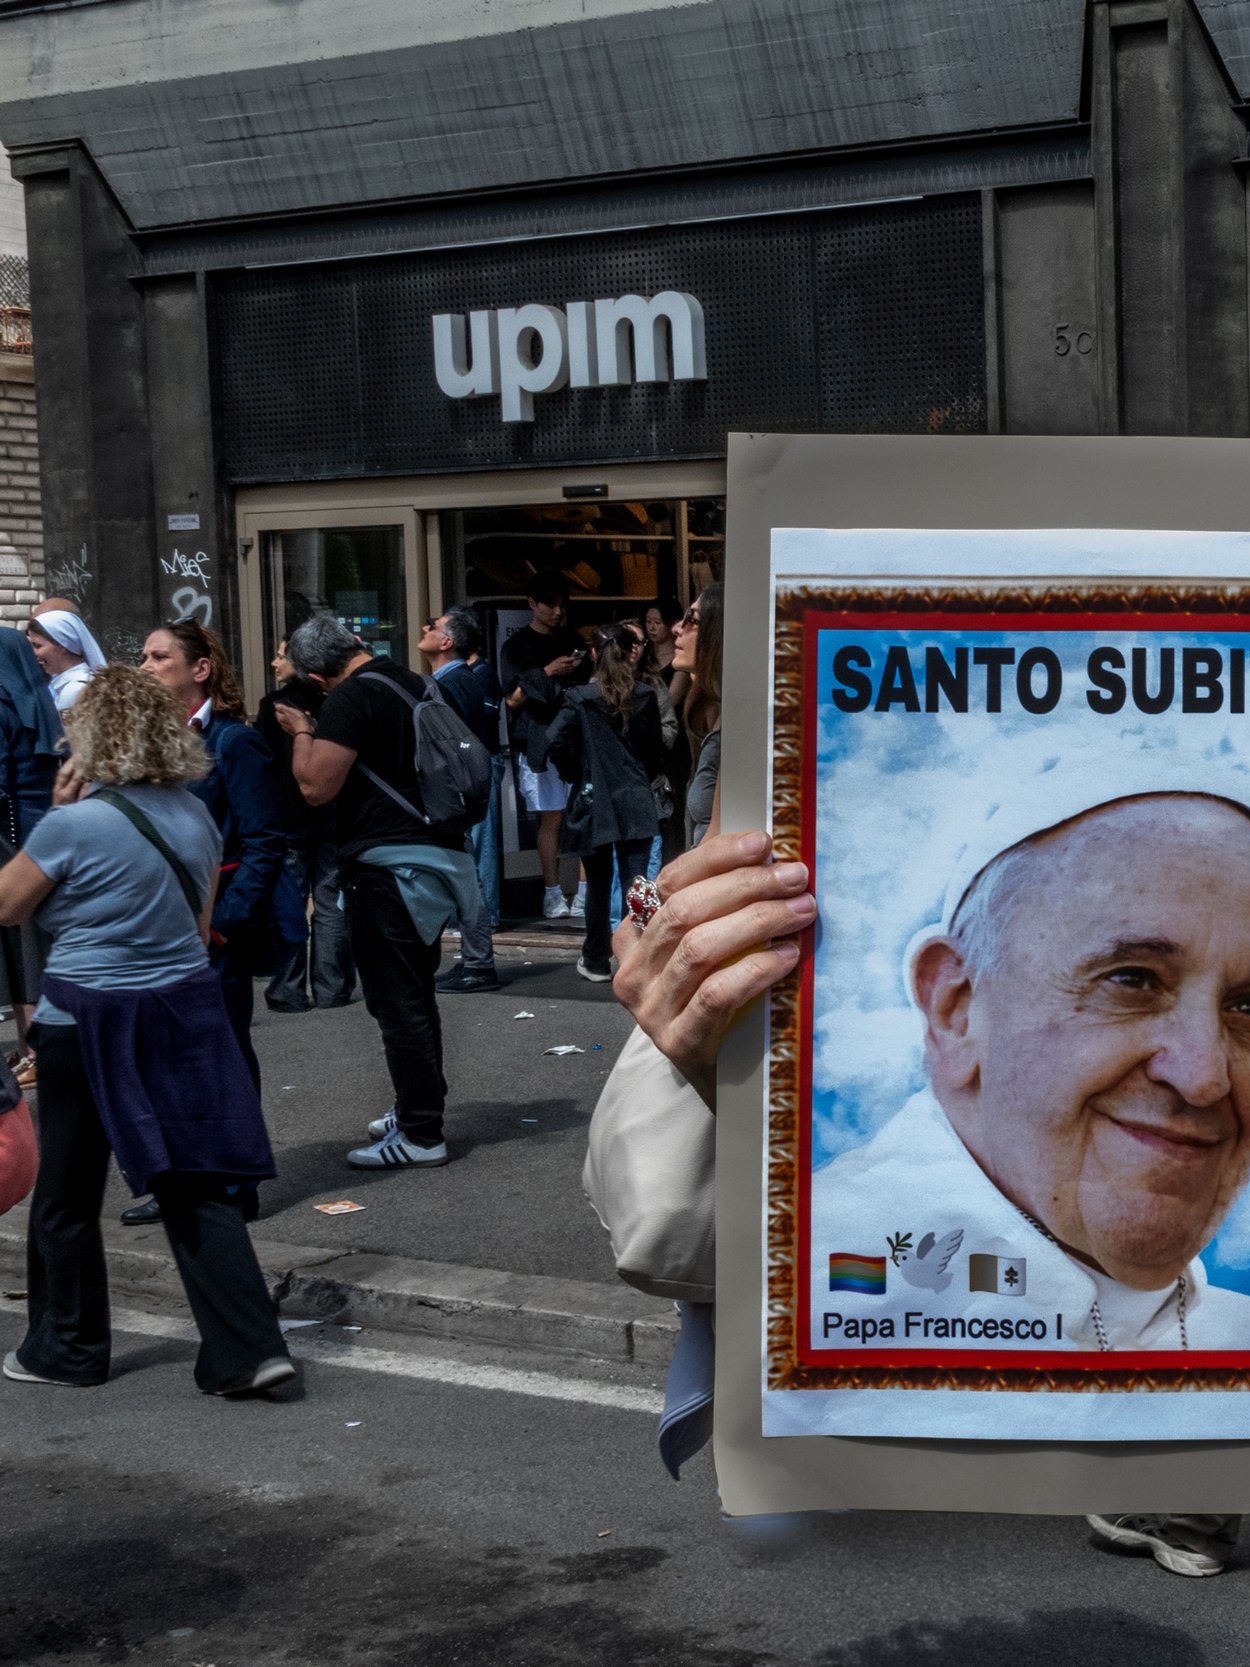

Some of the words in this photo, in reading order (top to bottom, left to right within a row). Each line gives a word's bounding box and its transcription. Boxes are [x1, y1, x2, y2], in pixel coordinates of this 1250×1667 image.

[432, 290, 707, 422] upim
[831, 645, 1063, 715] SANTO
[823, 1312, 895, 1344] Papa
[904, 1312, 1047, 1340] Francesco
[1056, 1313, 1063, 1340] I
